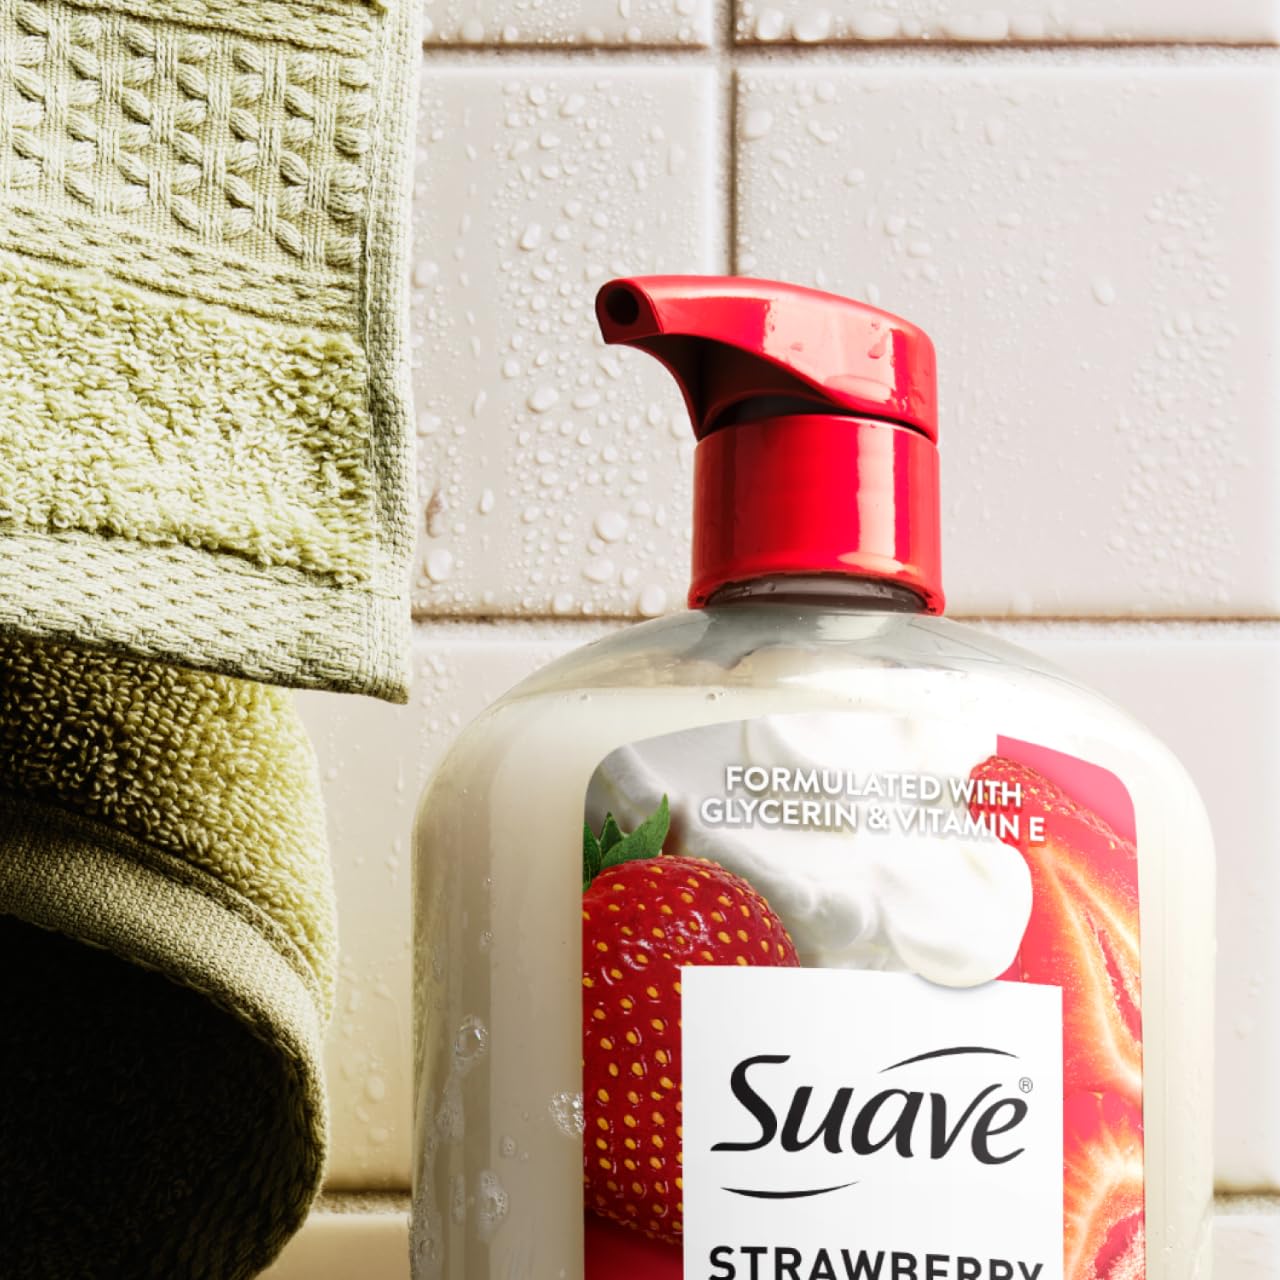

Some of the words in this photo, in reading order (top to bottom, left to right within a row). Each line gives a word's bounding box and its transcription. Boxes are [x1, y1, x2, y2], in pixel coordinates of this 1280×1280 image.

[726, 766, 941, 801] FORMULATED
[948, 778, 1023, 807] WITH
[701, 799, 858, 828] GLYCERIN
[869, 807, 890, 830] &
[892, 808, 1020, 841] VITAMIN
[1030, 816, 1046, 842] E
